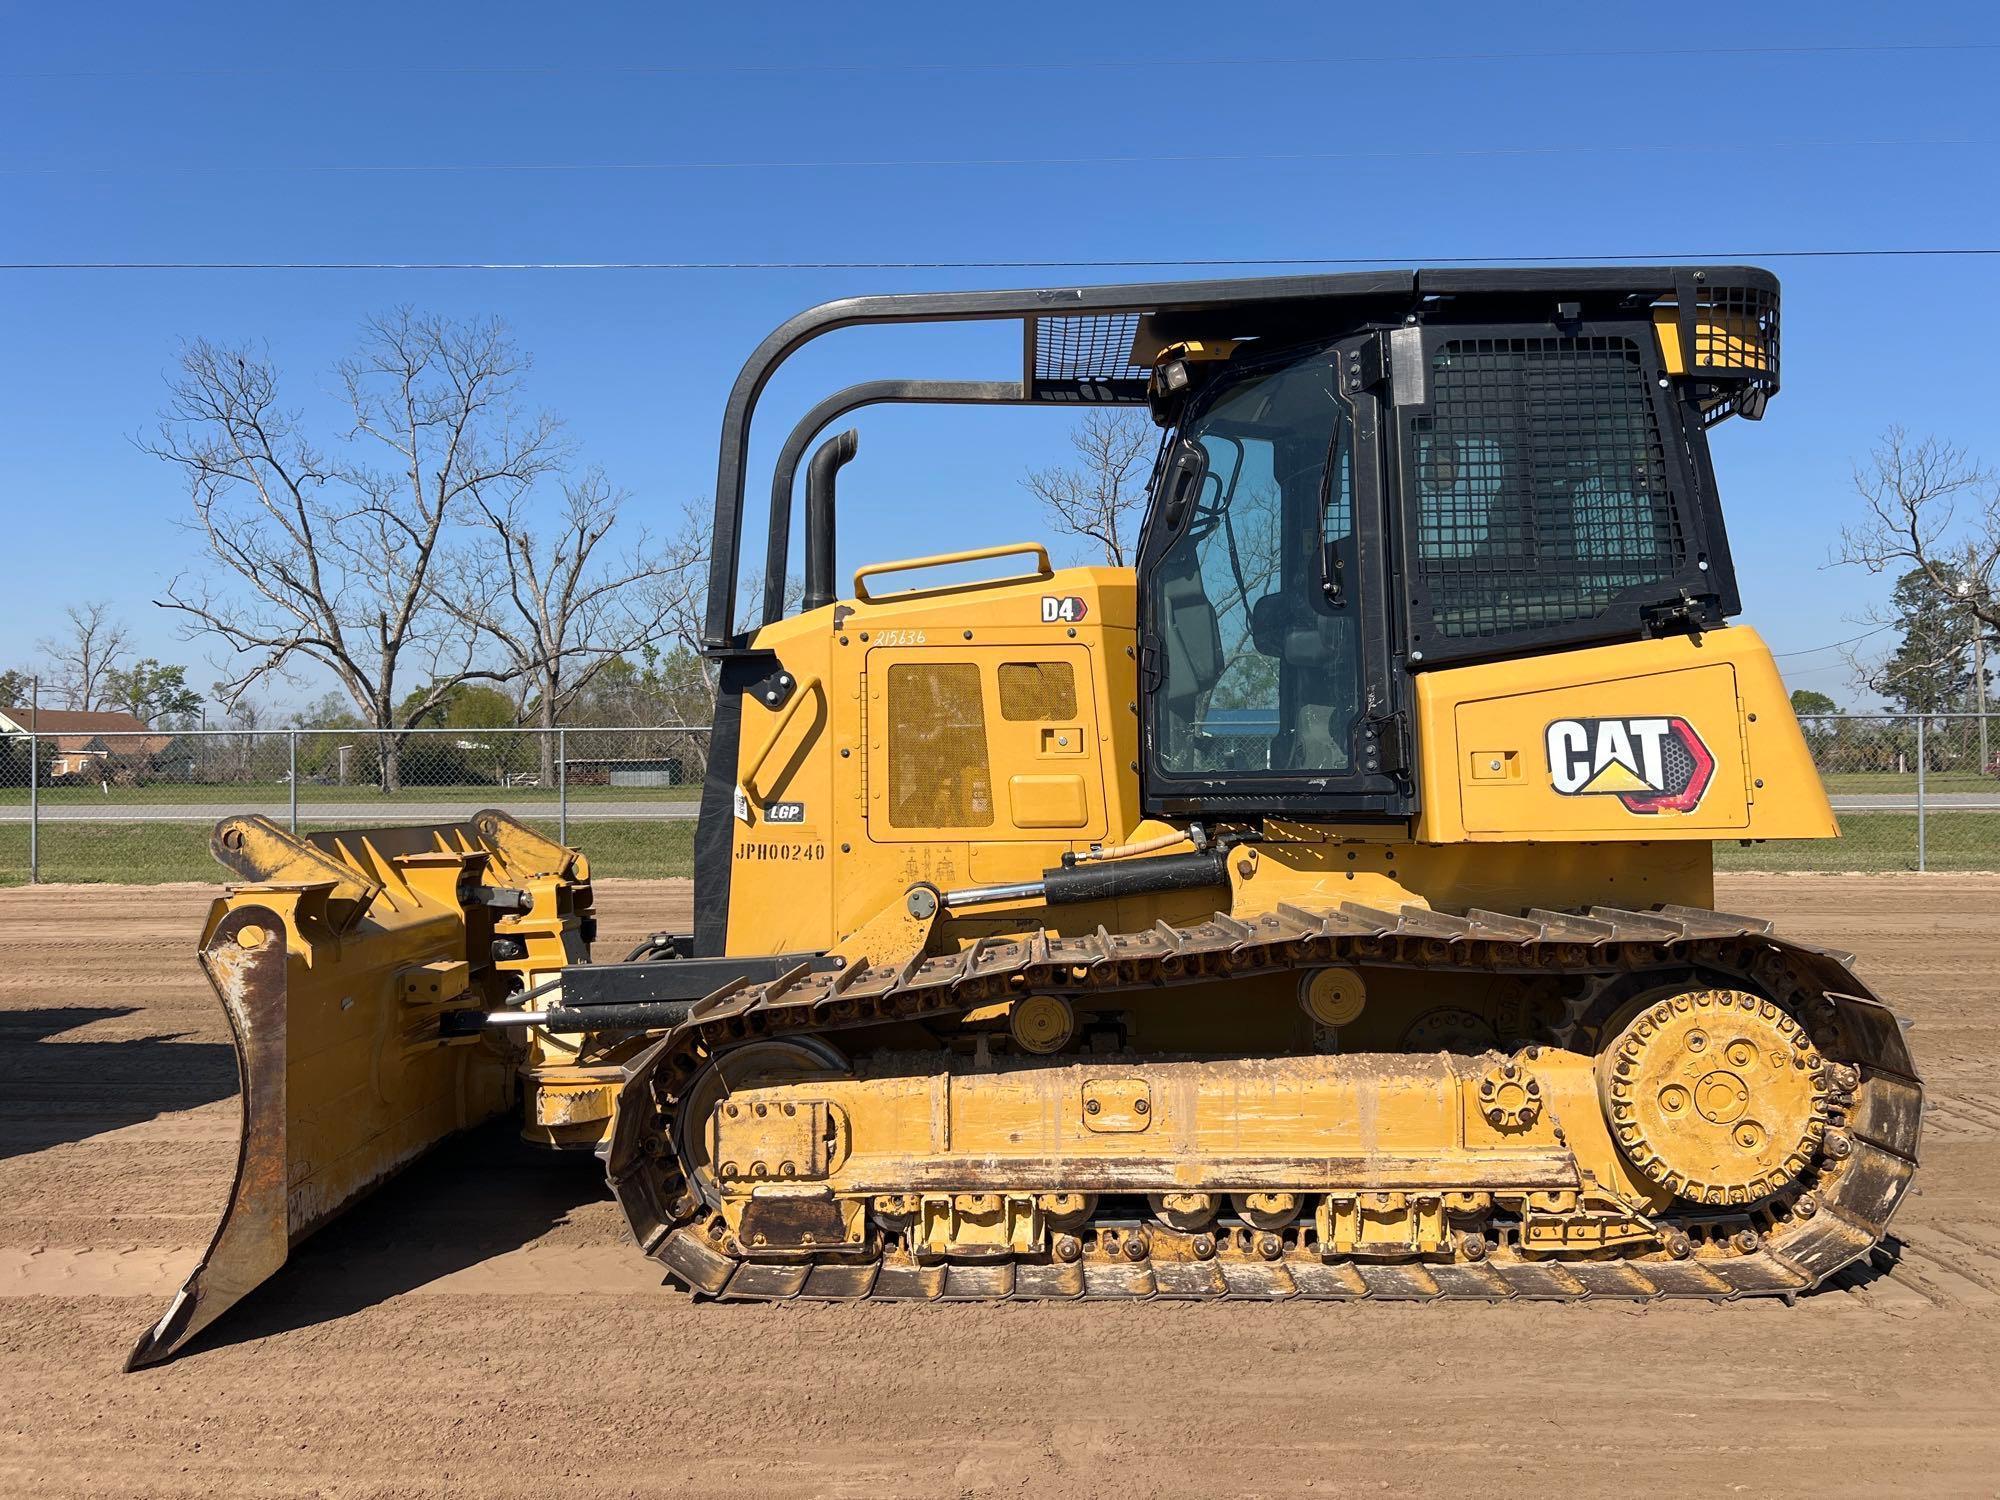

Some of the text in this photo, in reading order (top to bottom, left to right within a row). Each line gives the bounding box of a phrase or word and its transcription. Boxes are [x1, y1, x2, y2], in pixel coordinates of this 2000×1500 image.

[1042, 597, 1074, 621] D4
[873, 630, 926, 646] 215636
[1547, 719, 1669, 793] CAT
[770, 805, 800, 819] LGP
[735, 843, 824, 861] JPH00240
